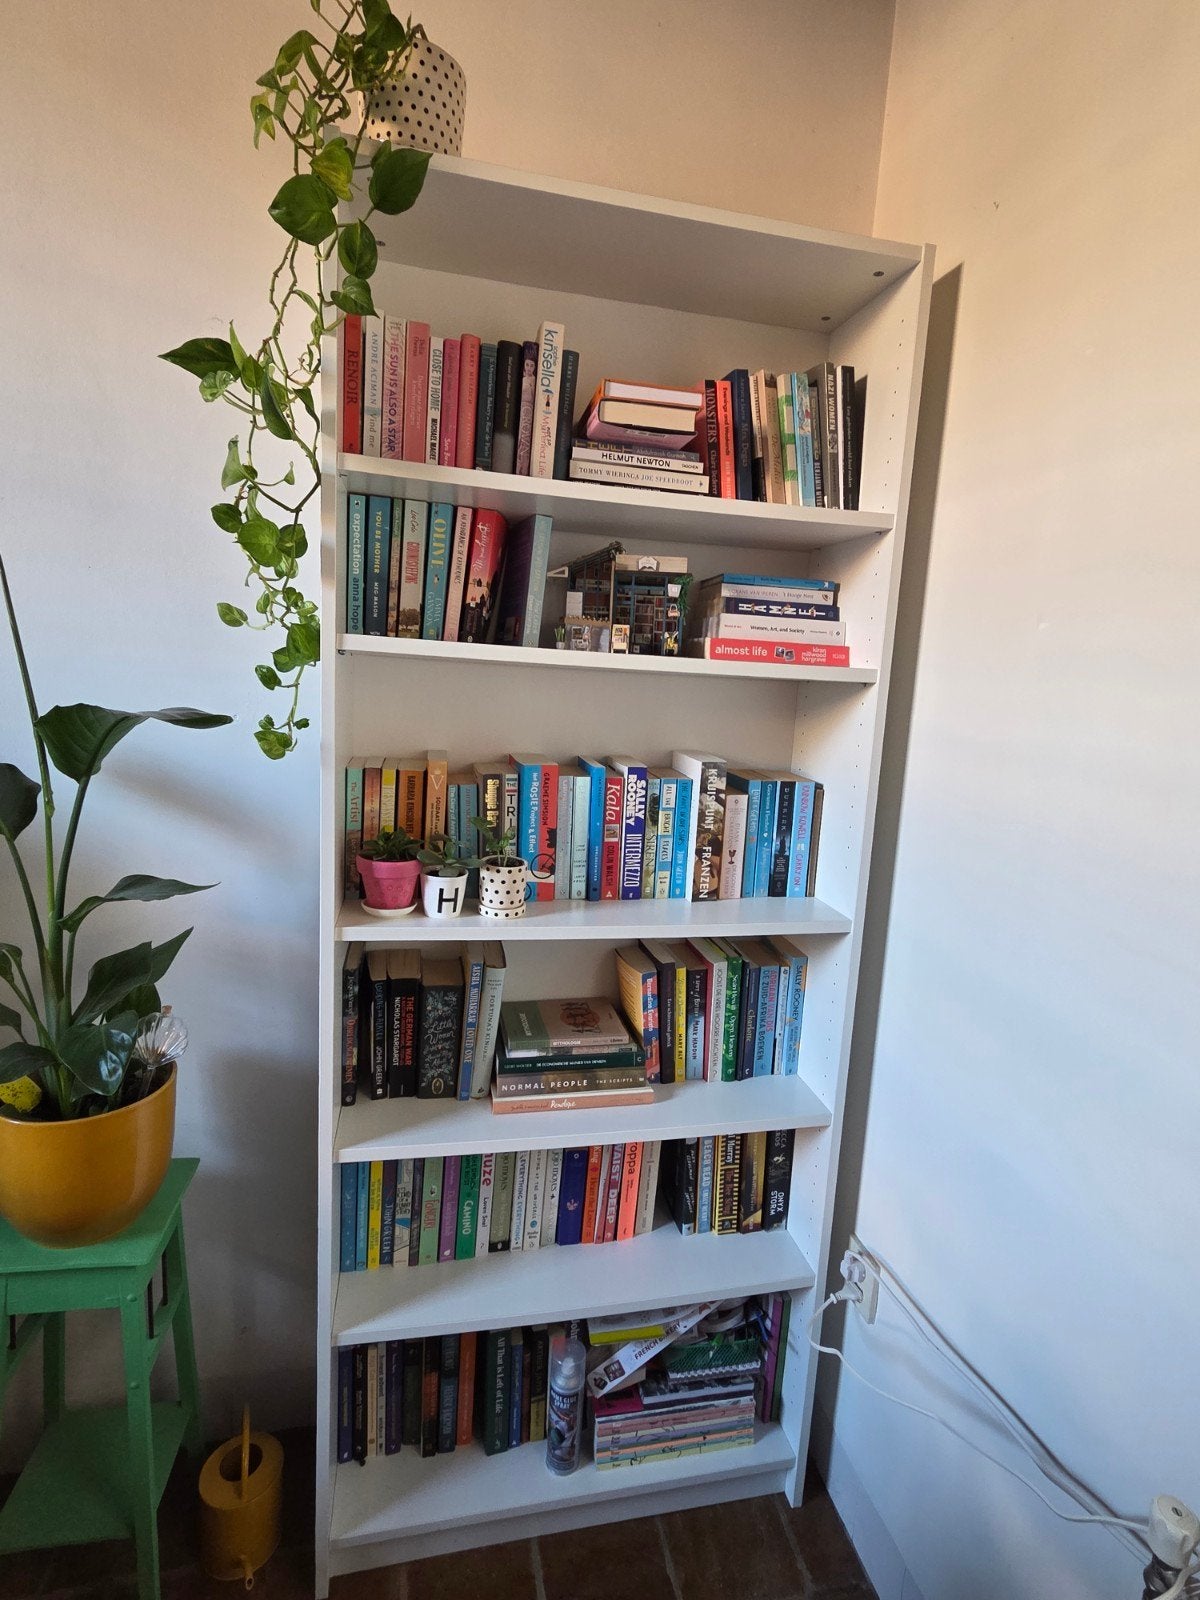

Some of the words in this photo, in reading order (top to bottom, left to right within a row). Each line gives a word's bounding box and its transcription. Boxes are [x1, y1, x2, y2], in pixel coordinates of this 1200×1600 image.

[390, 334, 400, 352] THE
[390, 354, 398, 377] SUN
[432, 349, 442, 374] CLOSE
[541, 329, 558, 388] kinsella
[347, 350, 359, 404] RENOIR
[370, 367, 378, 405] ACIMAN
[390, 379, 397, 387] IS
[432, 376, 441, 386] TO
[487, 363, 495, 395] Mysterious
[389, 390, 397, 416] ALSO
[430, 386, 440, 411] HOME
[485, 397, 493, 416] Bakery
[563, 383, 572, 415] MULISCH
[369, 413, 377, 432] Vind
[388, 418, 395, 426] A
[706, 388, 717, 443] MONSTERS
[388, 428, 396, 452] STAR
[430, 418, 438, 440] MICHAEL
[369, 435, 375, 448] me
[538, 461, 548, 476] Life
[602, 452, 634, 462] HELMUT
[636, 457, 671, 468] NEWTON
[579, 467, 604, 475] TOMMY
[605, 470, 640, 480] WIERINGA
[655, 477, 693, 486] SPEEDBOOT
[352, 513, 361, 574] expectation
[375, 530, 381, 539] BE
[430, 518, 447, 569] OLIVE
[351, 604, 360, 631] hope
[425, 591, 434, 626] GANNON
[434, 598, 443, 622] EMMA
[739, 603, 826, 616] HAMNET
[715, 645, 749, 656] almost
[752, 647, 767, 656] life
[407, 776, 416, 800] BARBARA
[485, 779, 500, 809] Shuggie
[530, 782, 539, 806] ROSIE
[542, 772, 550, 798] GRAEME
[350, 795, 360, 823] Artist
[606, 783, 620, 822] Kala
[626, 775, 637, 826] ROONEY
[635, 780, 646, 819] SALLY
[704, 768, 718, 830] KRUISPUNT
[781, 787, 790, 831] DUNKIRK
[801, 785, 809, 814] RAINBOW
[405, 802, 415, 834] KINGSOLVER
[486, 811, 499, 827] Bain
[530, 806, 538, 827] Project
[662, 813, 671, 833] BRIGHT
[797, 815, 805, 840] ROWELL
[528, 835, 536, 853] Effect
[606, 845, 615, 863] COLIN
[661, 840, 670, 860] PLACES
[624, 834, 642, 887] INTERMEZZO
[677, 850, 685, 864] JOHN
[606, 865, 615, 886] WALSH
[699, 846, 712, 898] FRANZEN
[794, 876, 800, 885] ON
[437, 887, 459, 913] H
[472, 965, 481, 985] AISHA
[762, 970, 768, 980] DE
[768, 970, 777, 1002] ADRIAAN
[375, 982, 383, 1009] LOOKING
[406, 997, 415, 1011] THE
[715, 989, 722, 997] DE
[758, 981, 768, 1029] ZUID-AFRIKA
[792, 988, 800, 1020] ROONEY
[405, 1014, 413, 1046] GERMAN
[424, 1031, 456, 1044] Women
[428, 1020, 453, 1034] Little
[465, 1027, 474, 1048] LOVED
[746, 1009, 755, 1042] Charlotte
[392, 1030, 400, 1066] STARGARDT
[464, 1049, 472, 1063] ONE
[728, 1034, 736, 1057] Heaven
[501, 1083, 545, 1091] NORMAL
[550, 1100, 577, 1109] Penelope
[591, 1146, 601, 1163] King
[703, 1140, 712, 1165] BEACH
[725, 1140, 734, 1163] Murray
[518, 1159, 526, 1199] EVERYTHING
[702, 1166, 710, 1187] READ
[384, 1204, 394, 1224] JOHN
[607, 1189, 619, 1224] DEEP
[723, 1198, 731, 1215] Sting
[769, 1190, 777, 1215] STORM
[462, 1200, 473, 1235] CAMINO
[515, 1201, 523, 1241] EVERYTHING
[383, 1226, 391, 1253] GREEN
[497, 1348, 505, 1365] That
[634, 1339, 659, 1360] FRENCH
[496, 1375, 504, 1388] Left
[495, 1399, 503, 1414] Life
